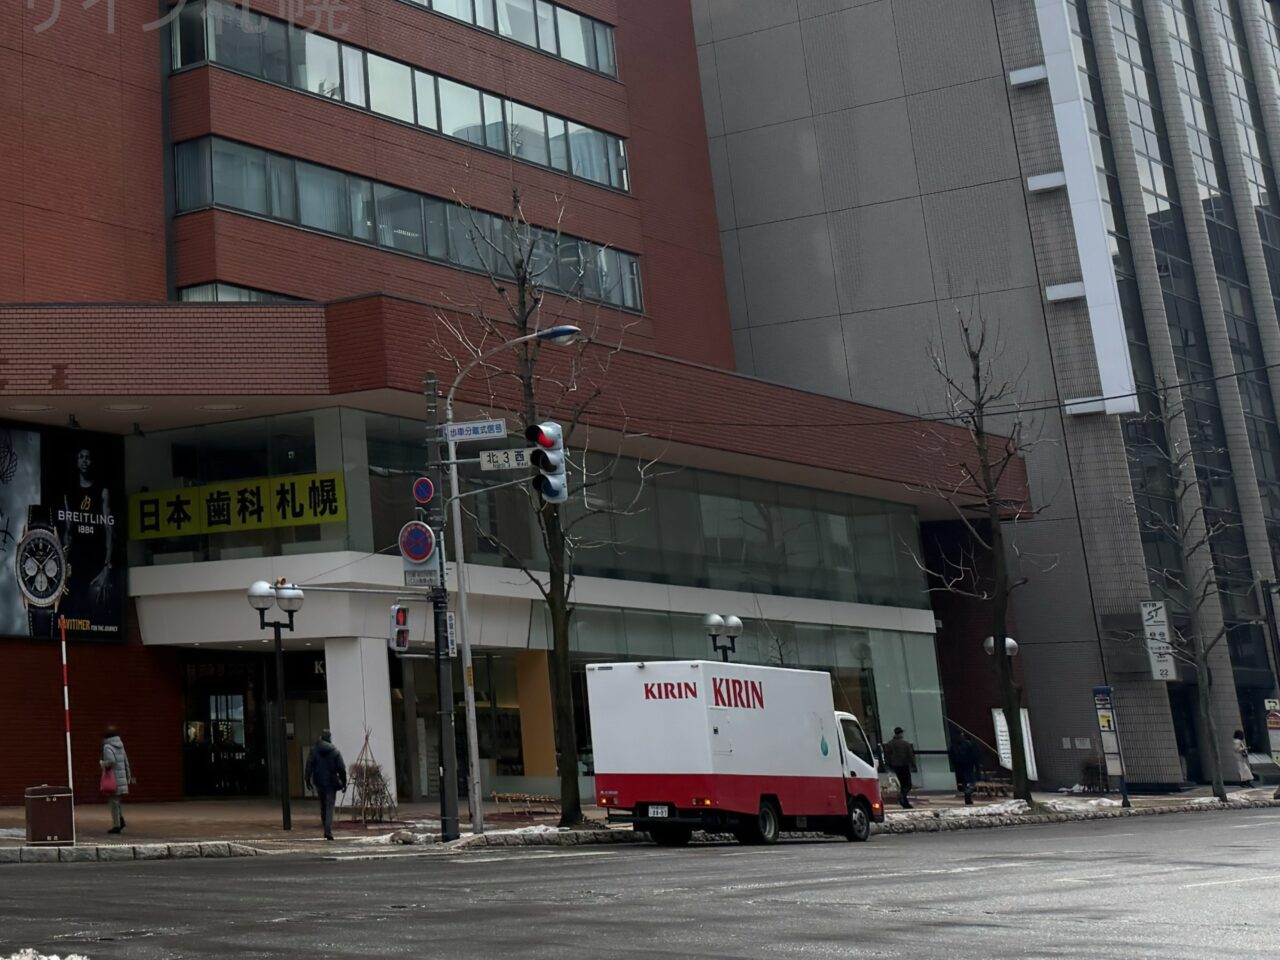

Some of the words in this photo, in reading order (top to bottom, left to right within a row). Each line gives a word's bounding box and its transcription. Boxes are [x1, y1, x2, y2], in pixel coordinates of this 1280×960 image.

[58, 510, 115, 526] BREITLING
[78, 525, 94, 534] 1884
[643, 681, 698, 700] KIRIN
[712, 677, 765, 710] KIRIN
